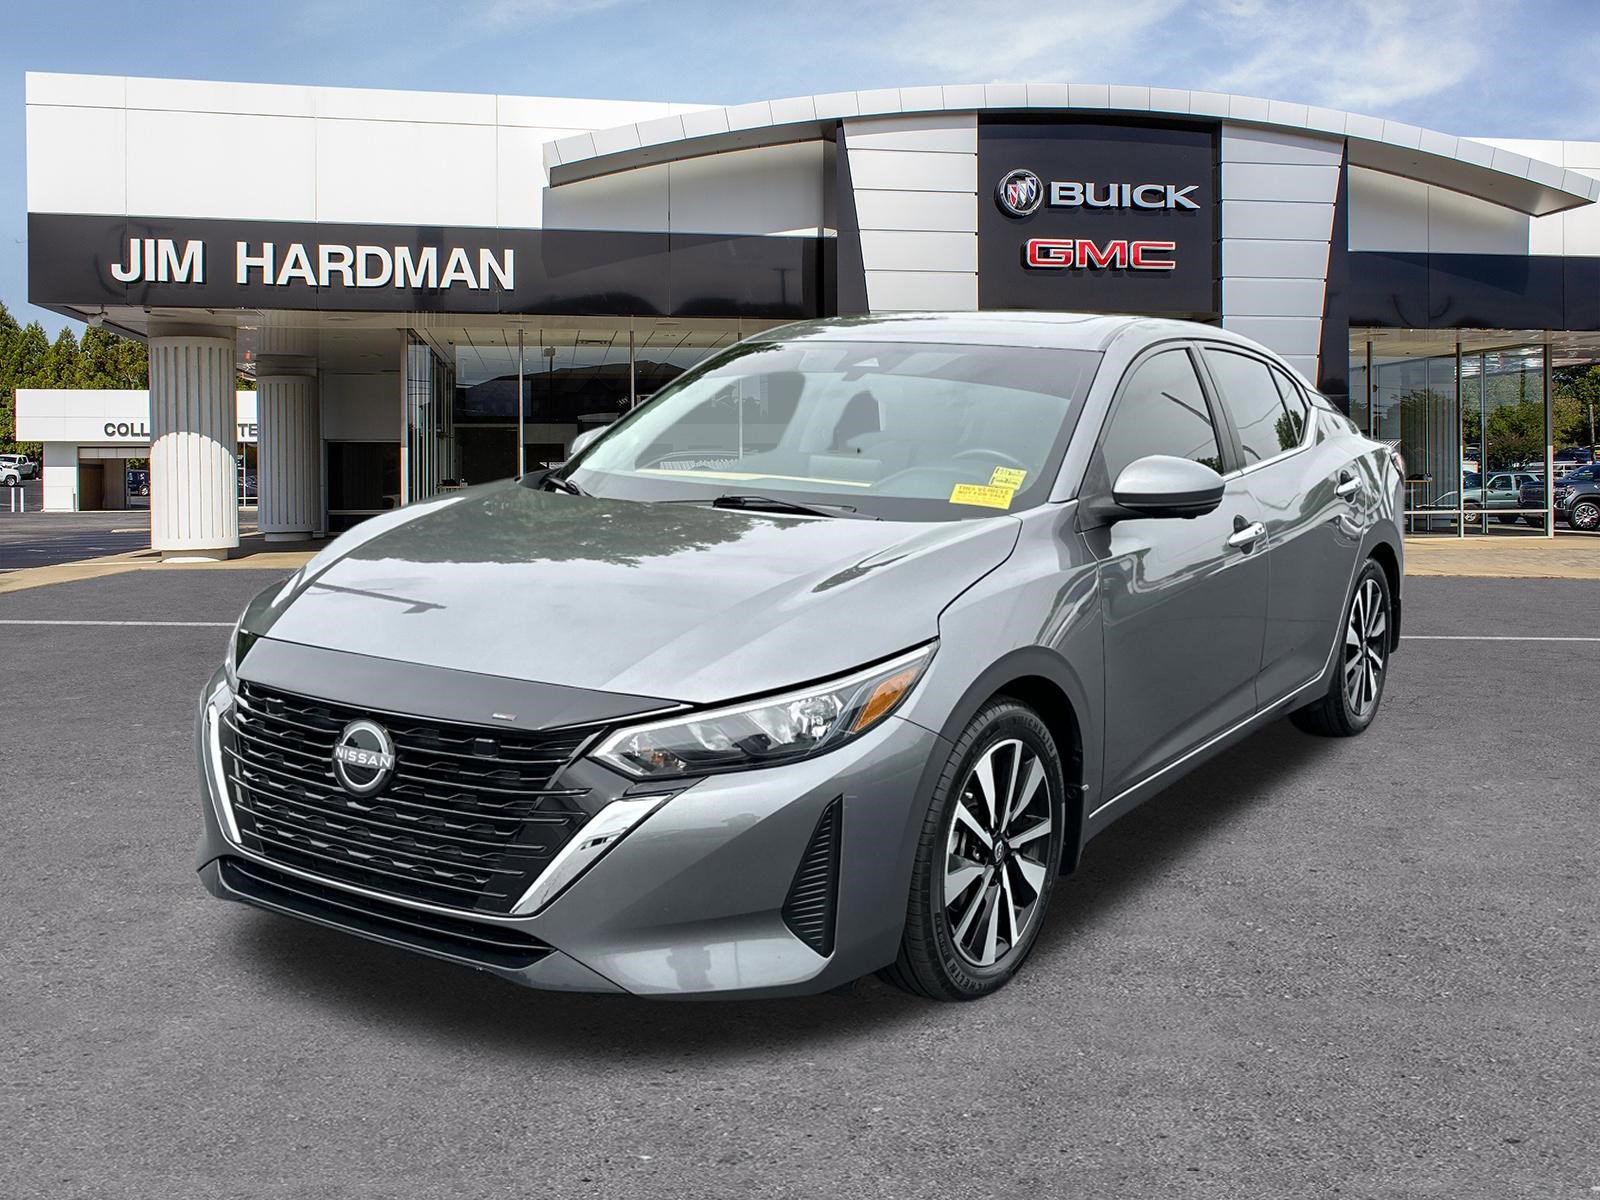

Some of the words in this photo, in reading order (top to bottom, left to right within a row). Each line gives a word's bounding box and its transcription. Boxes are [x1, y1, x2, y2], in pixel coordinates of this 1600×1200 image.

[1050, 181, 1200, 209] BUICK
[111, 238, 204, 283] JIM
[236, 241, 514, 291] HARDMAN
[1025, 238, 1176, 270] GMC
[335, 746, 391, 767] NISSAN
